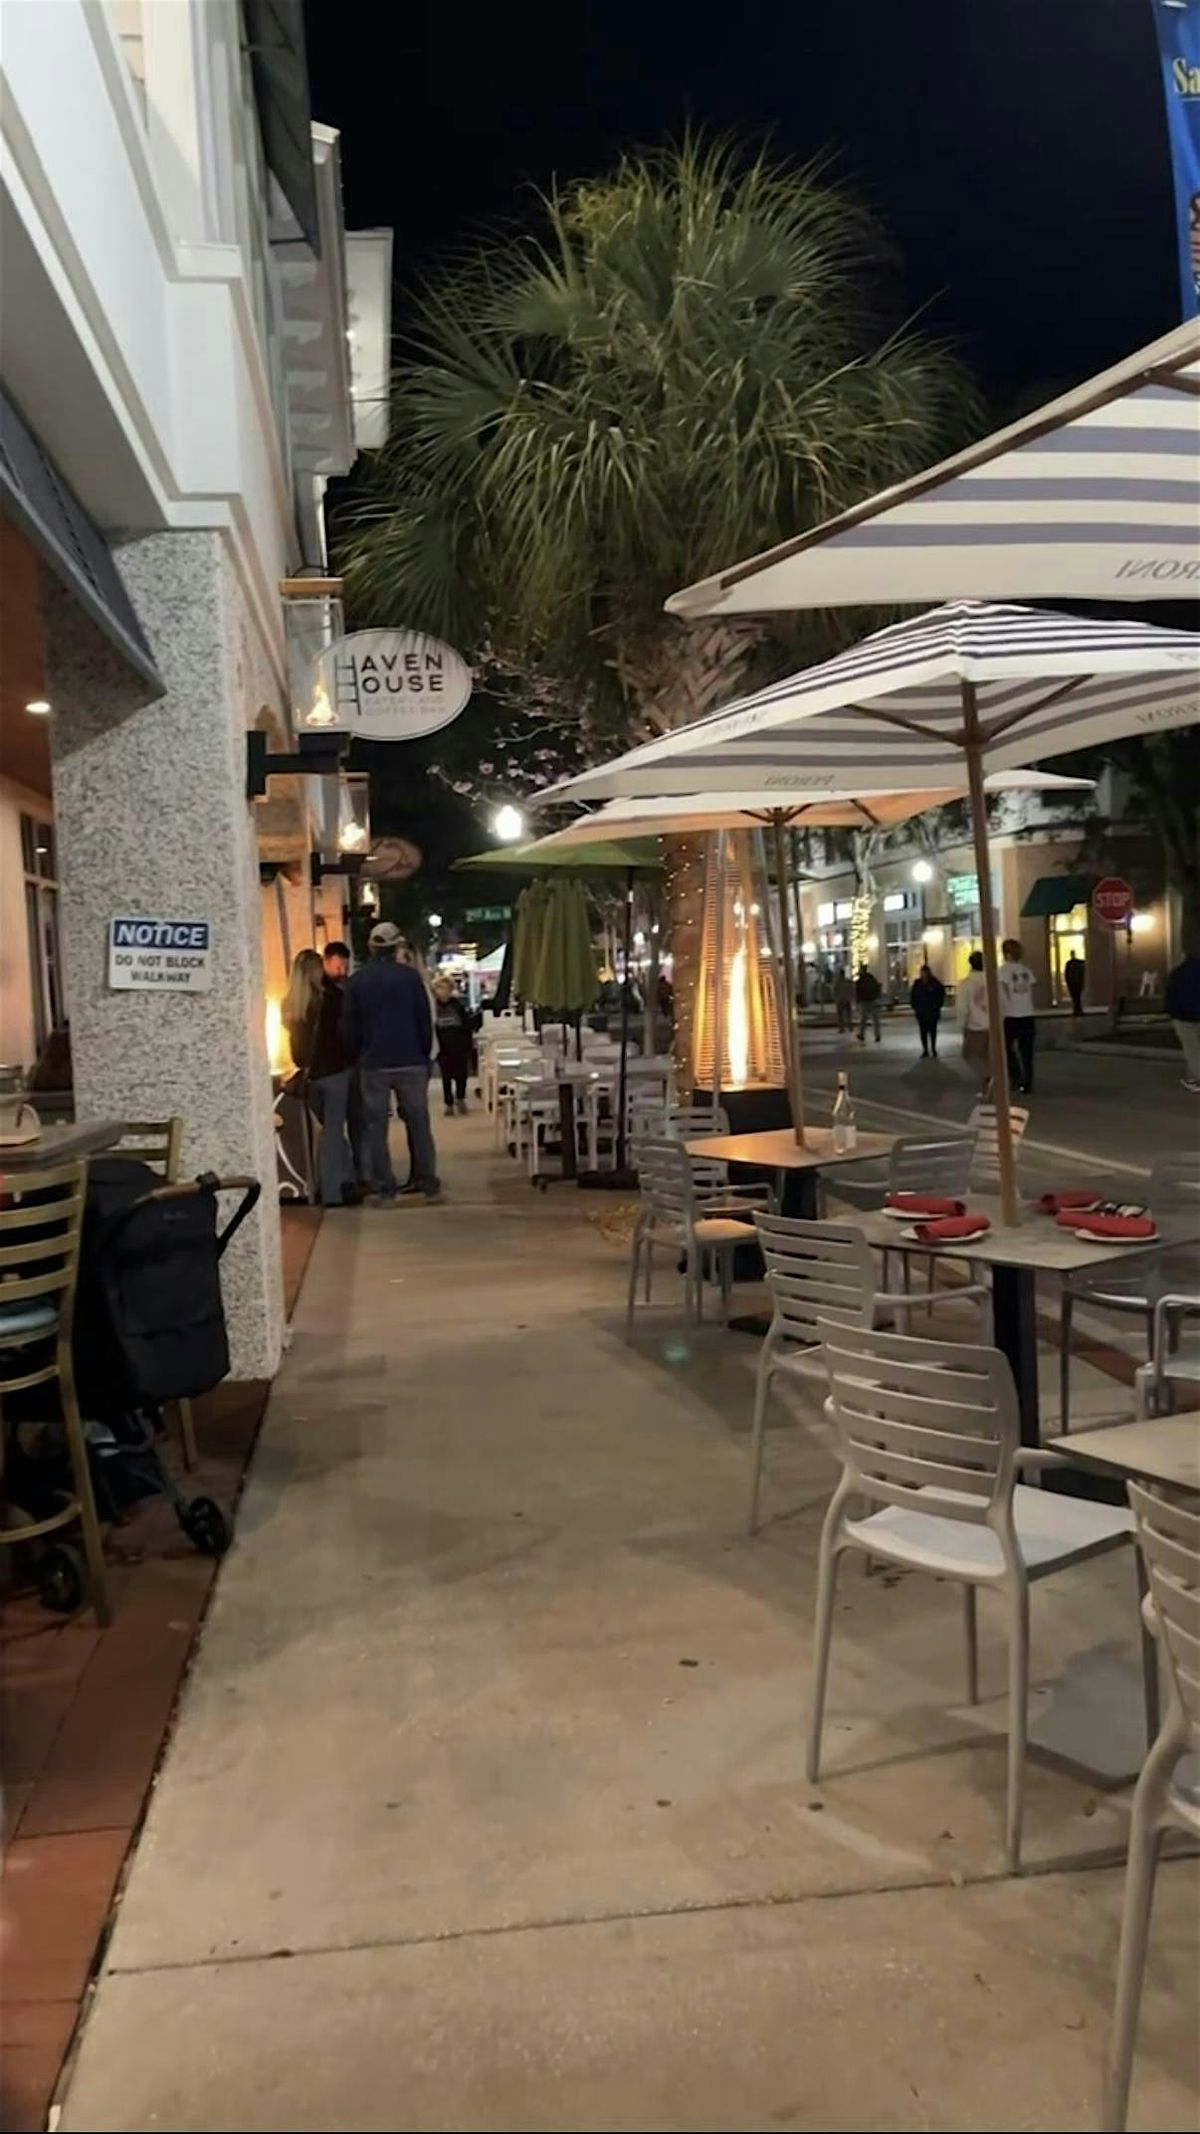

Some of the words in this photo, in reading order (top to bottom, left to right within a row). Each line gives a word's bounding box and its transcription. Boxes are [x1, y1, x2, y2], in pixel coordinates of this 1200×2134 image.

[1096, 892, 1130, 908] STOP
[117, 924, 205, 946] NOTICE
[115, 955, 133, 966] DO
[138, 955, 162, 967] NOT
[166, 957, 206, 969] BLOCK
[131, 970, 191, 983] WALKWAY
